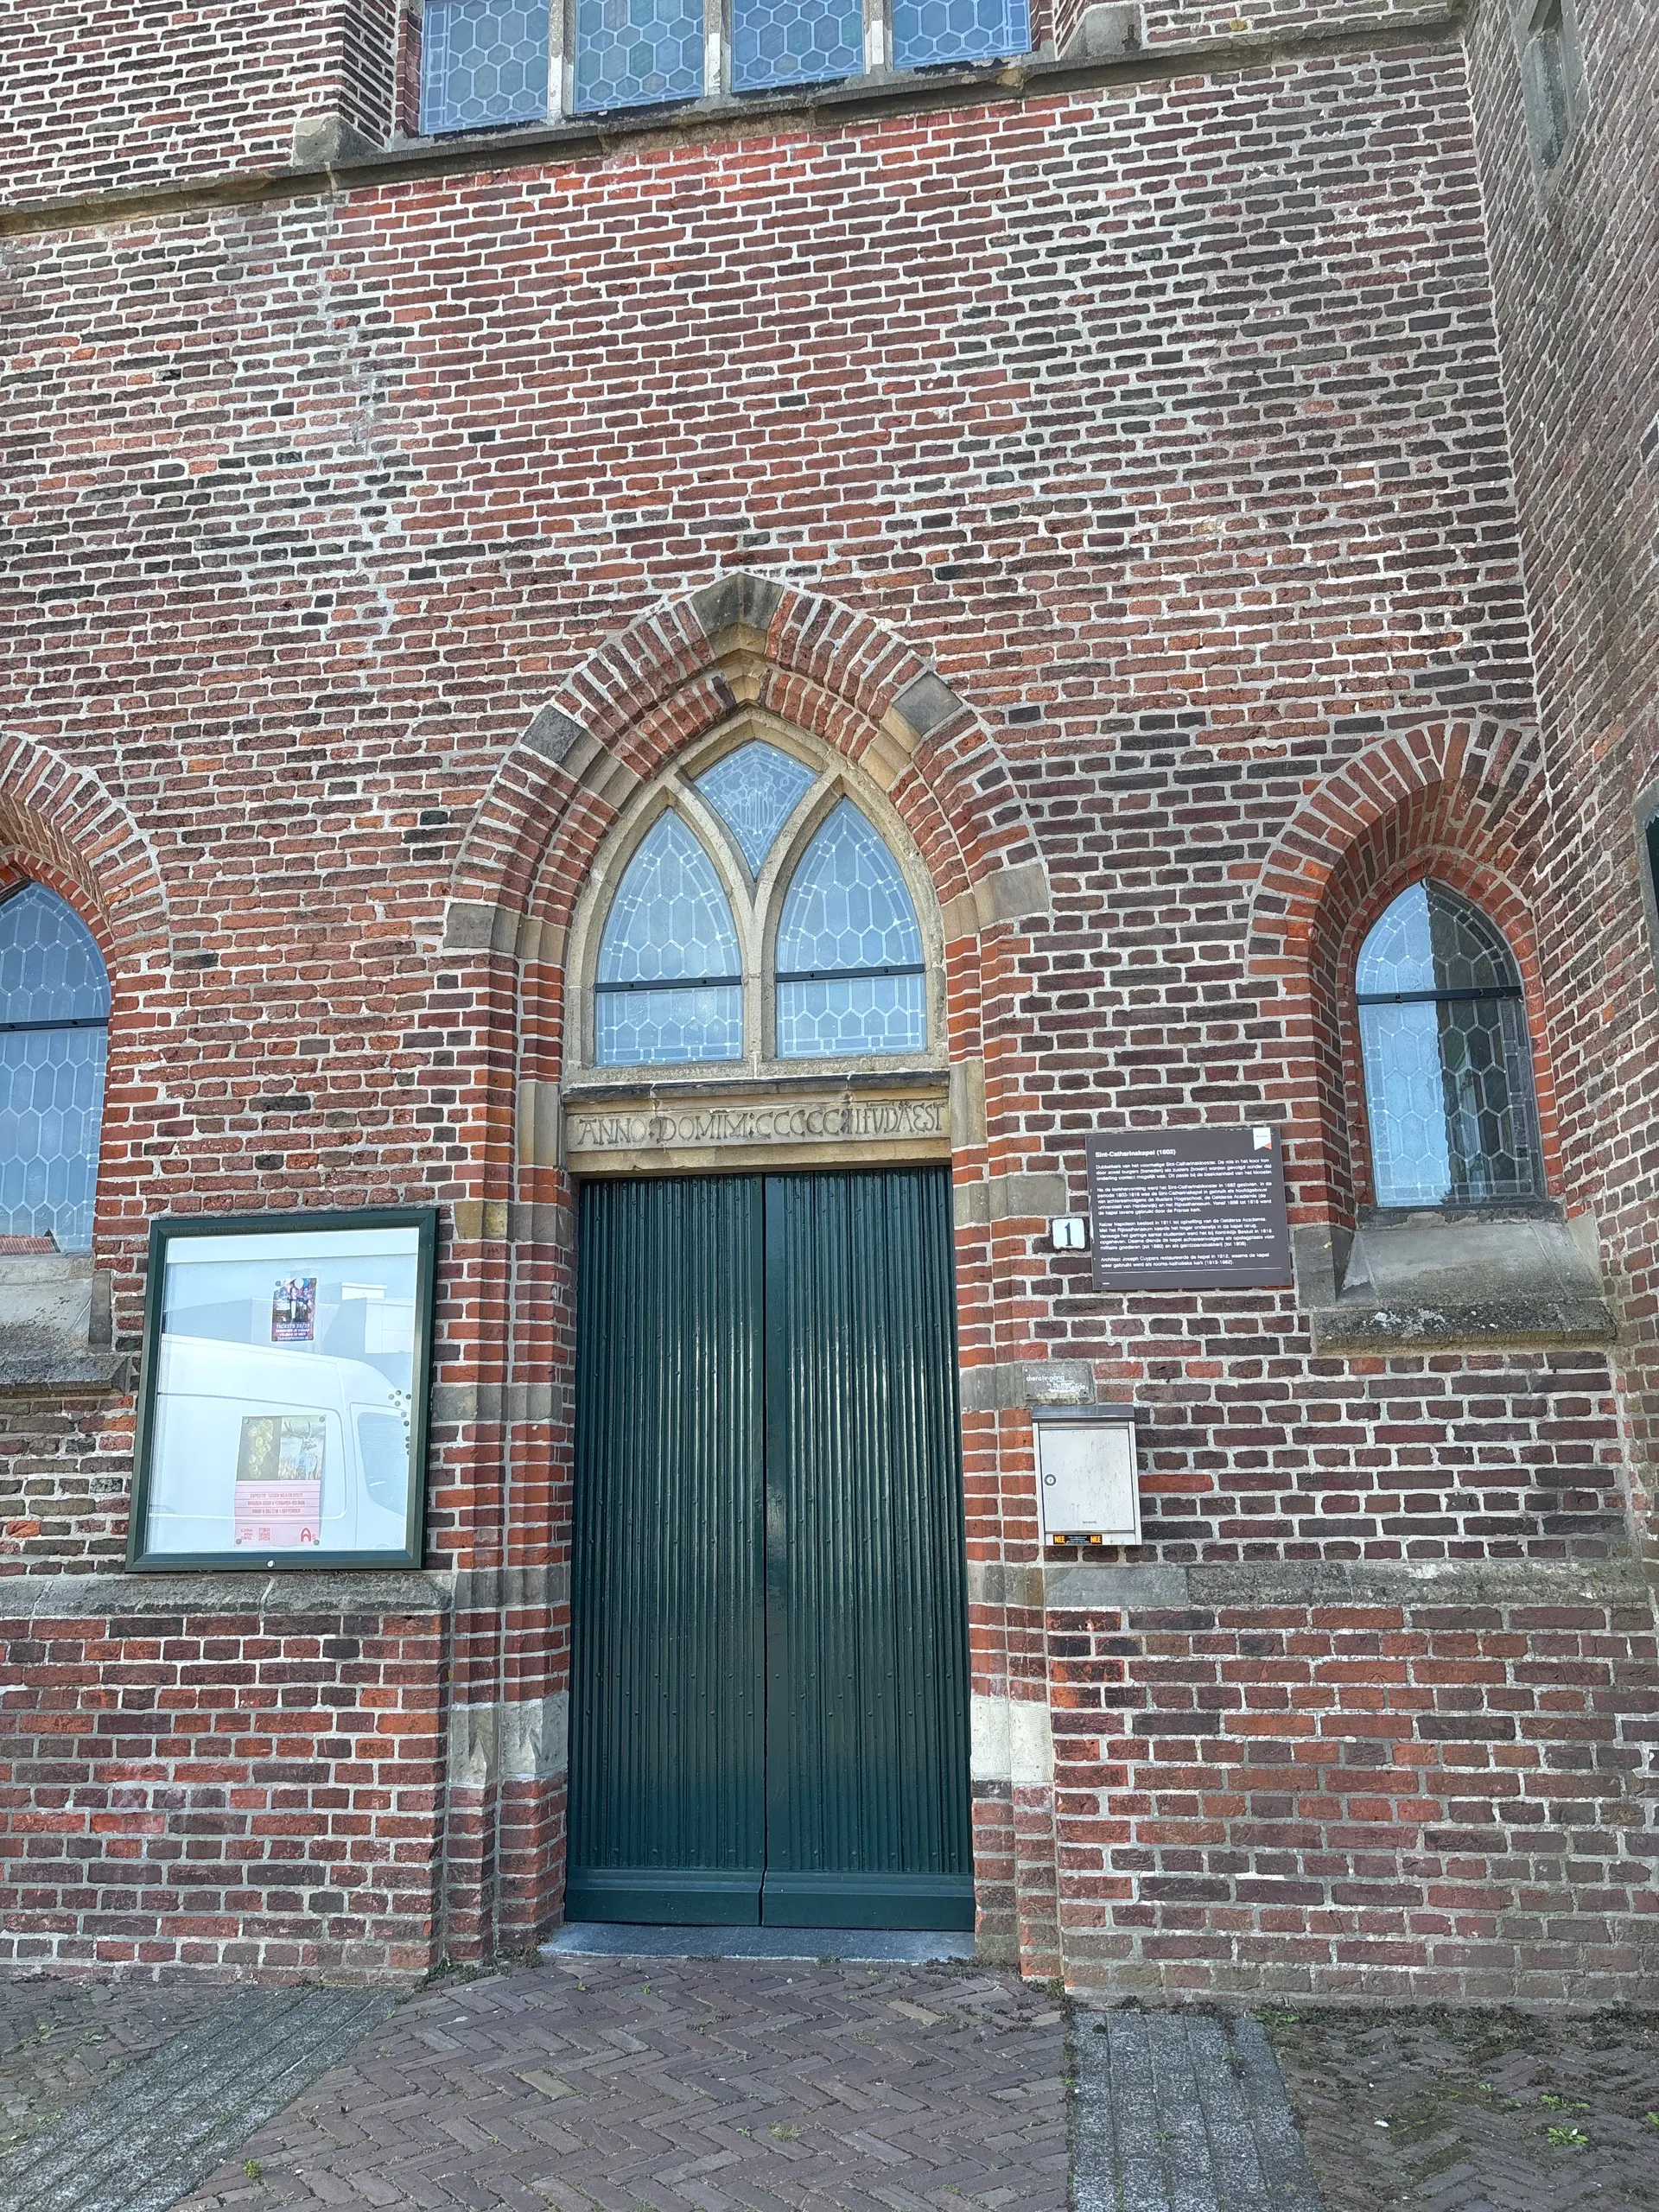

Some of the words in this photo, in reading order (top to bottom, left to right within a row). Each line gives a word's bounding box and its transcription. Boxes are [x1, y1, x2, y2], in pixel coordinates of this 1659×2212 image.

[1063, 1222, 1073, 1247] 1
[1054, 1535, 1065, 1544] NEE
[1090, 1535, 1102, 1544] NEE
